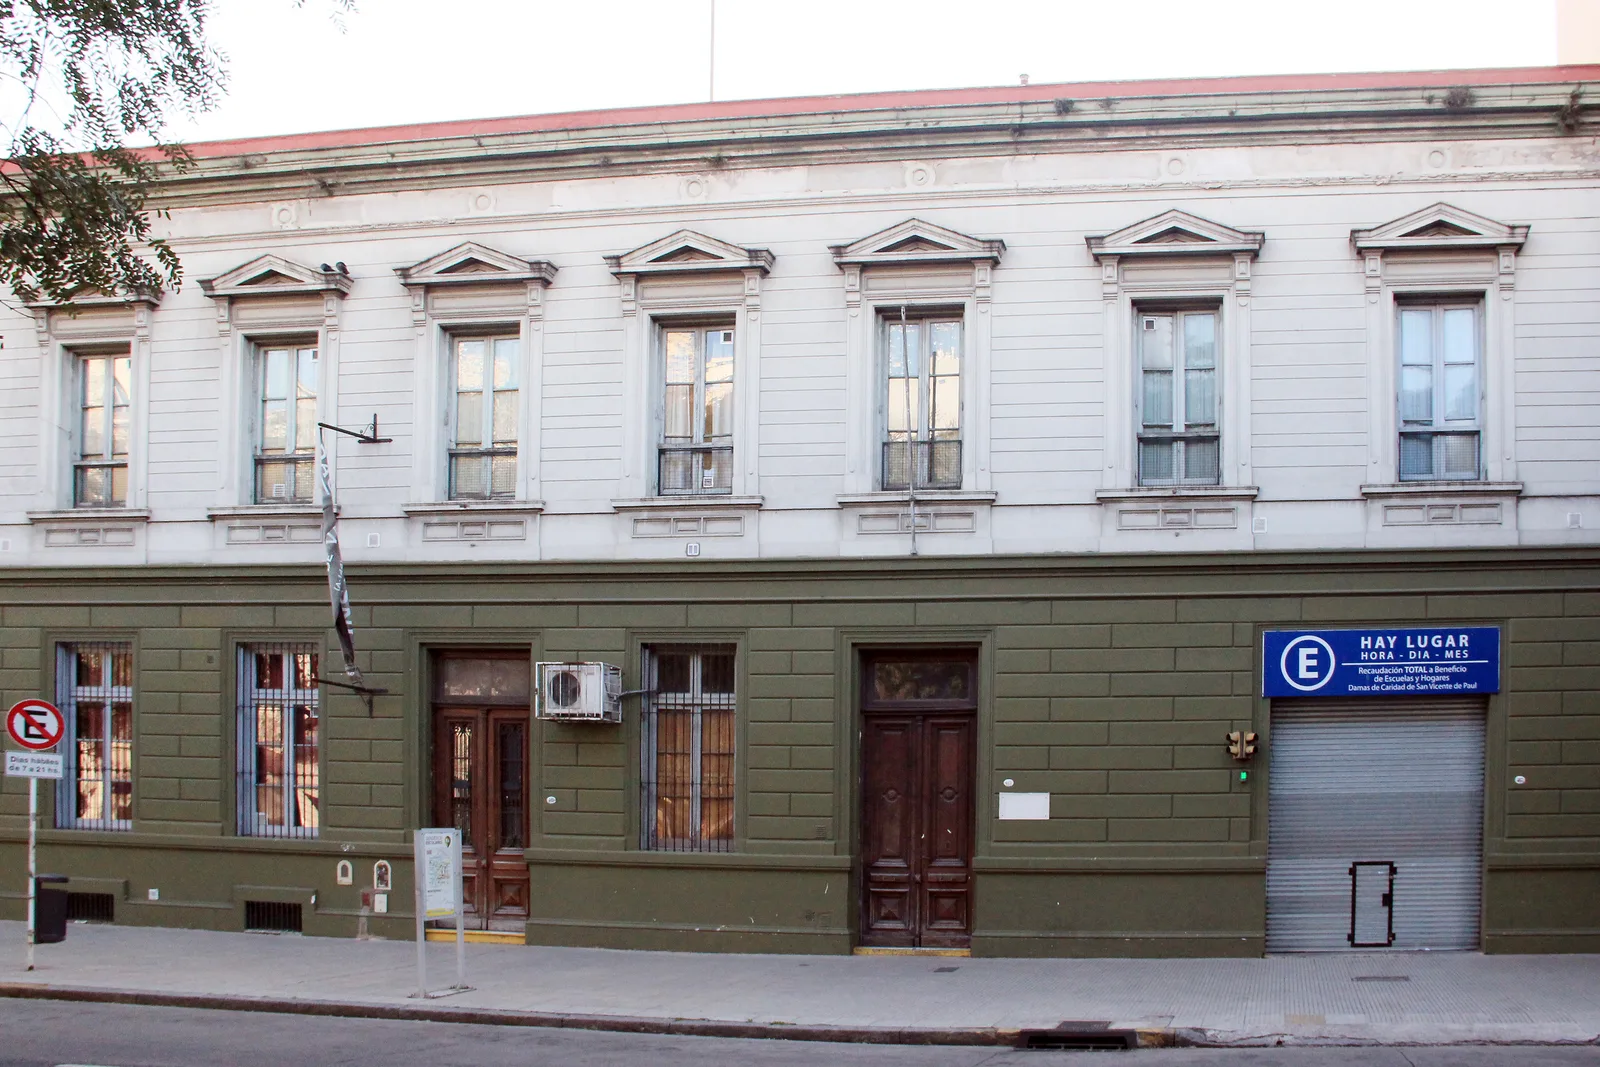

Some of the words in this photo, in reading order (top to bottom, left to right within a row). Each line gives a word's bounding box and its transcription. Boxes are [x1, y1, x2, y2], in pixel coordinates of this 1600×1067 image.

[1361, 636, 1397, 649] HAY
[1407, 634, 1469, 648] LUGAR
[1361, 651, 1394, 660] HORA
[1409, 650, 1430, 659] DIA
[1445, 650, 1468, 658] MES
[1299, 648, 1319, 678] E
[1434, 665, 1467, 673] Beneficio
[1415, 676, 1420, 684] y
[1420, 674, 1450, 683] Hogares
